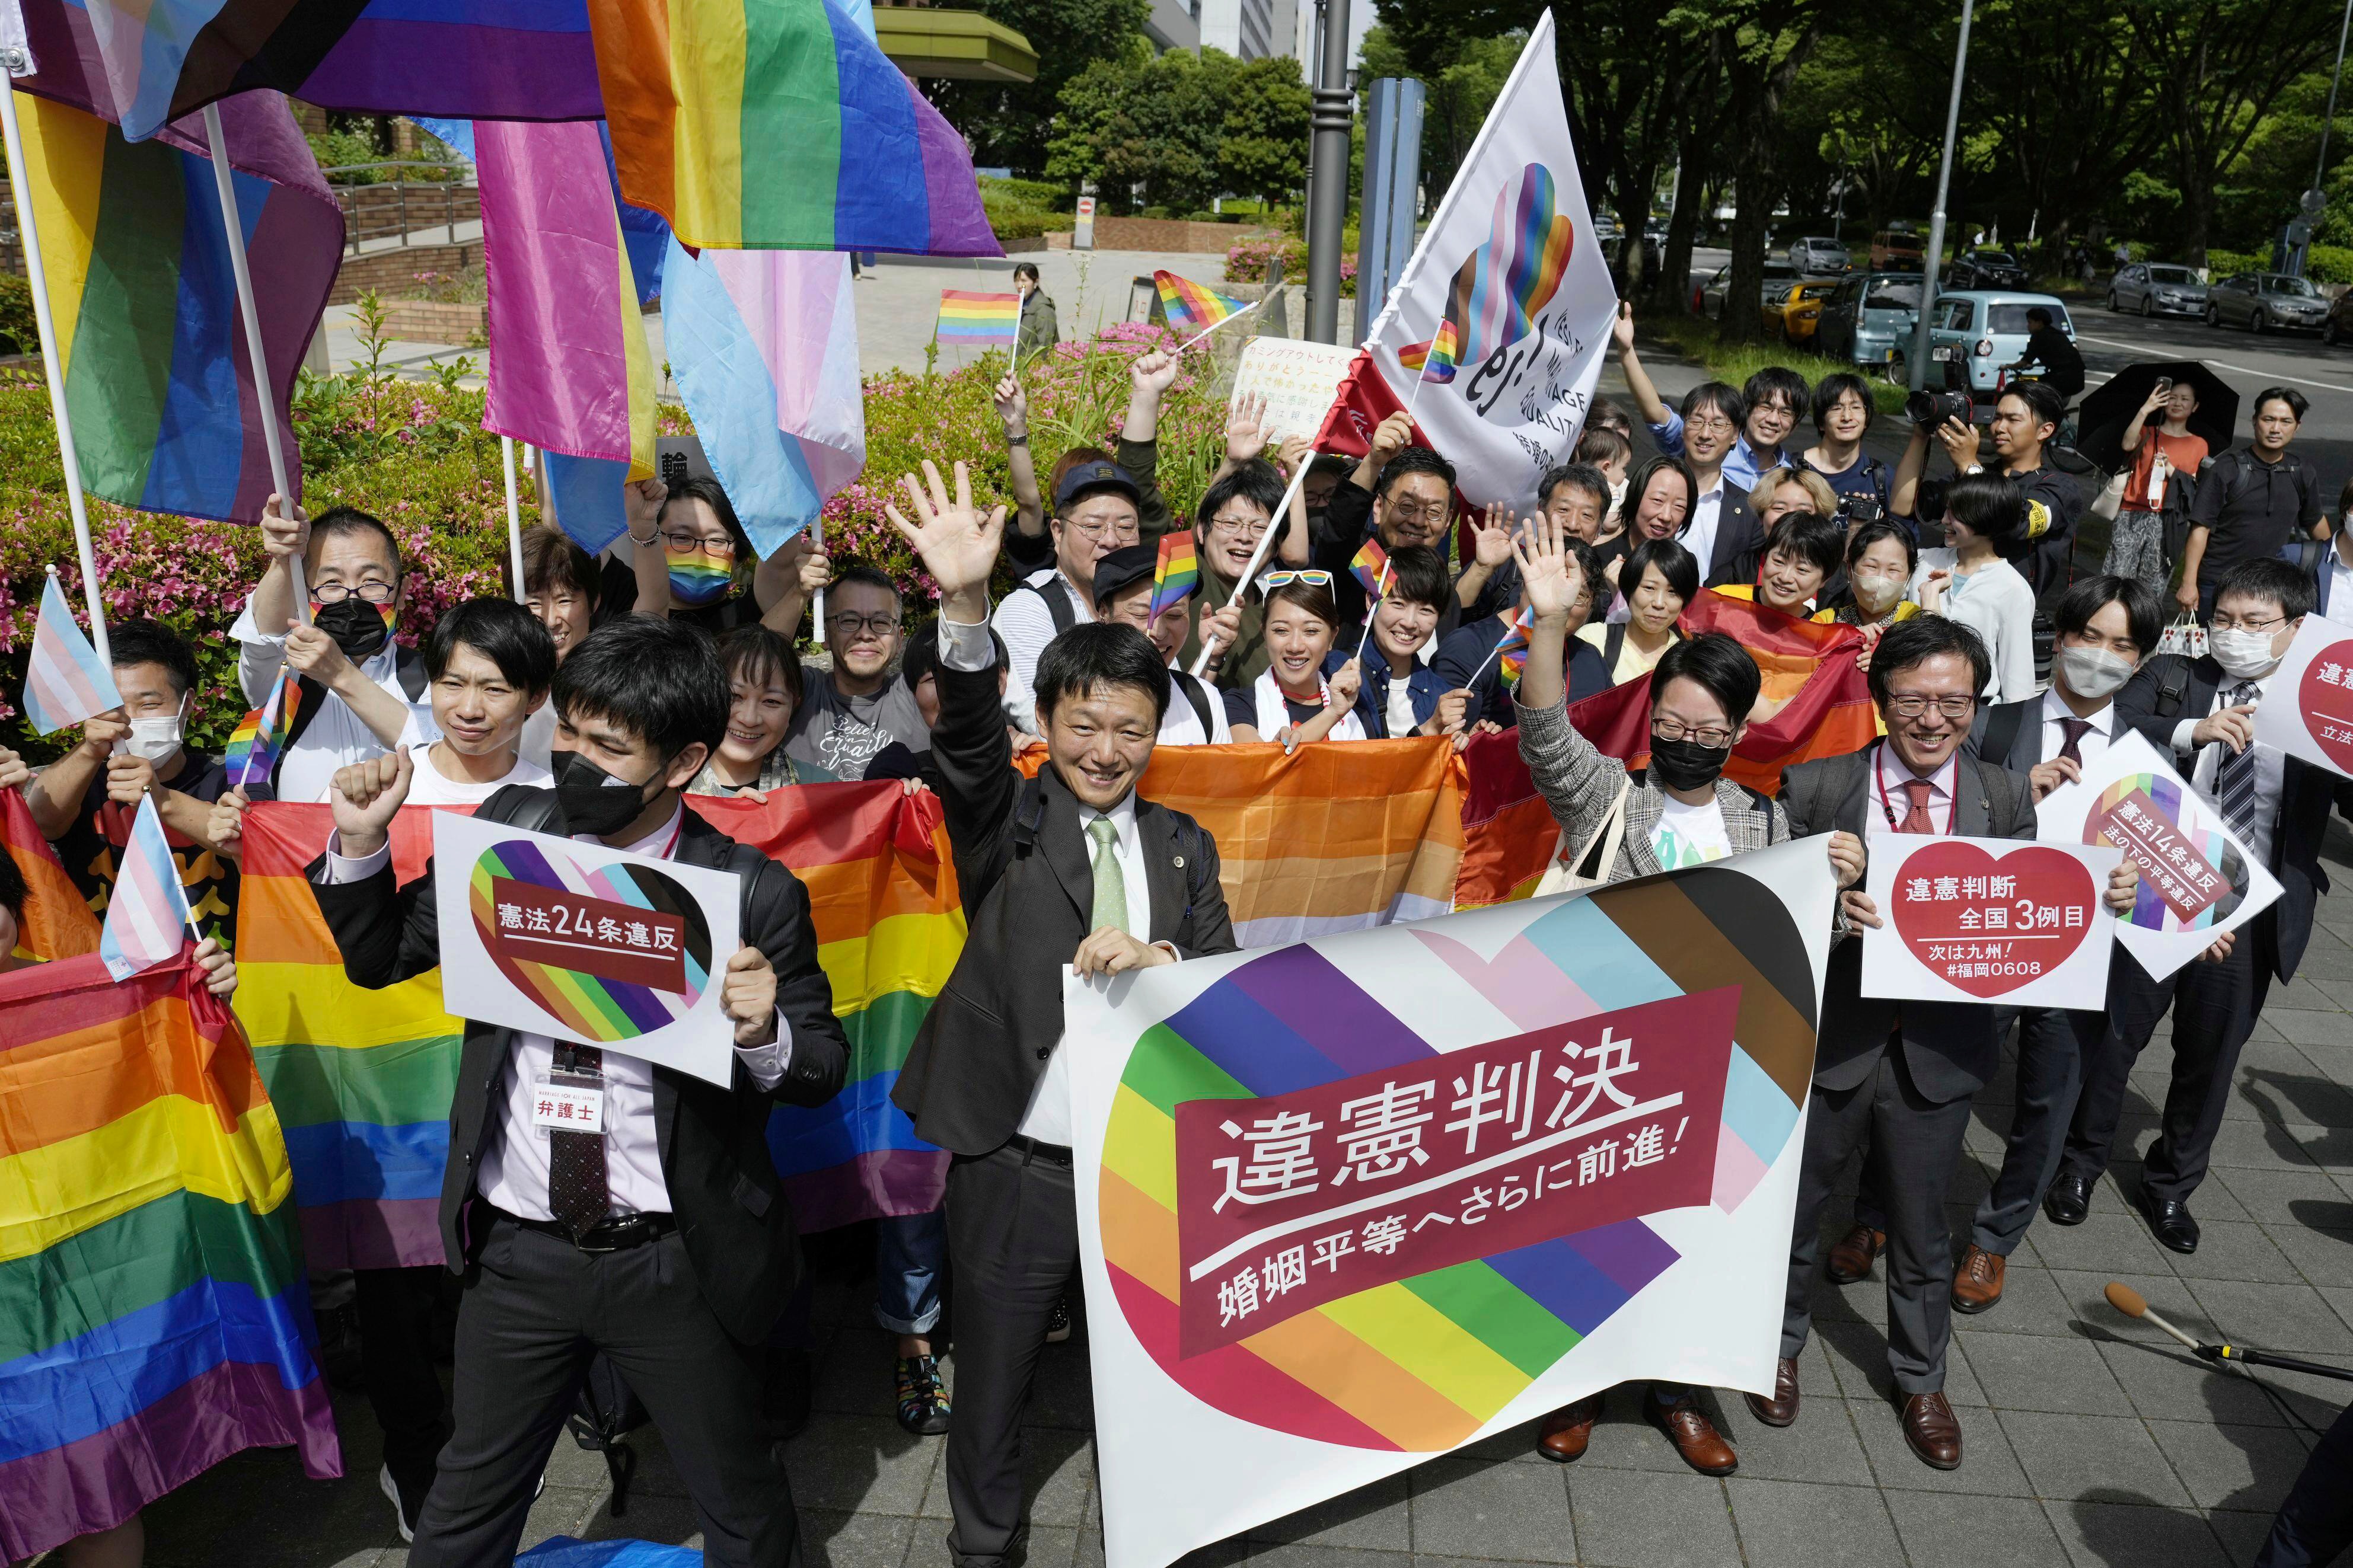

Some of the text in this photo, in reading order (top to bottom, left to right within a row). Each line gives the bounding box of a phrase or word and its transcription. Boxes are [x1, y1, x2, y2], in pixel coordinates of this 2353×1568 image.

[2103, 825, 2197, 911] 法の下の平等違反
[2118, 800, 2218, 893] 憲法14条違反
[1905, 874, 2016, 902] 違憲判断
[498, 902, 678, 953] 憲法24条違反
[1959, 899, 2084, 930] 全国3例目
[1947, 961, 2041, 979] #福岡0608
[538, 1100, 594, 1121] 弁護士
[1211, 1026, 1641, 1216] 違憲判決
[1216, 1116, 1689, 1329] 婚姻平等へさらに前進!
